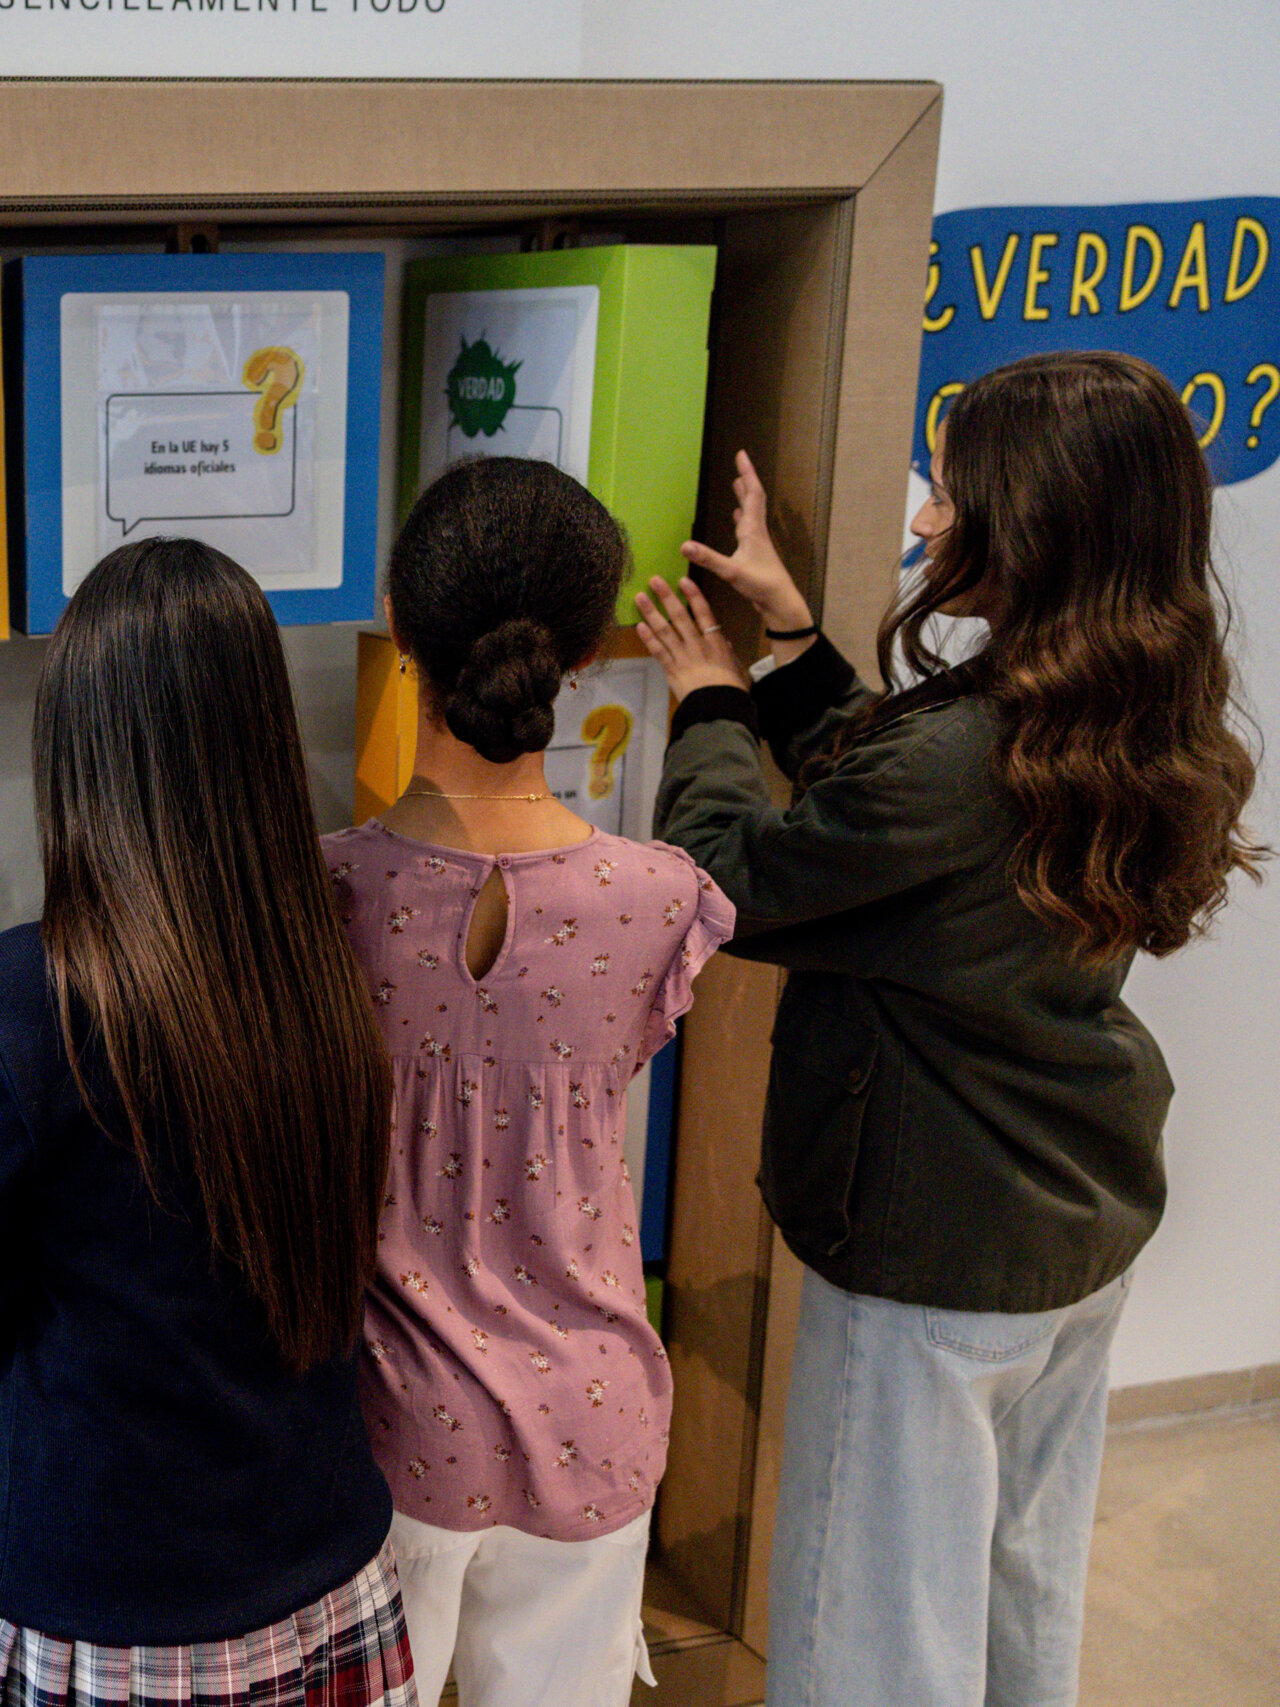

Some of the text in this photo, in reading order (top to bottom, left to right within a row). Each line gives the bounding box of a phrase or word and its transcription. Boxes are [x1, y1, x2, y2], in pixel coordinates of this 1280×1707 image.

[458, 376, 506, 402] VERDAD
[151, 439, 230, 455] En la UE hay 5
[144, 461, 236, 477] idiomas oficiales
